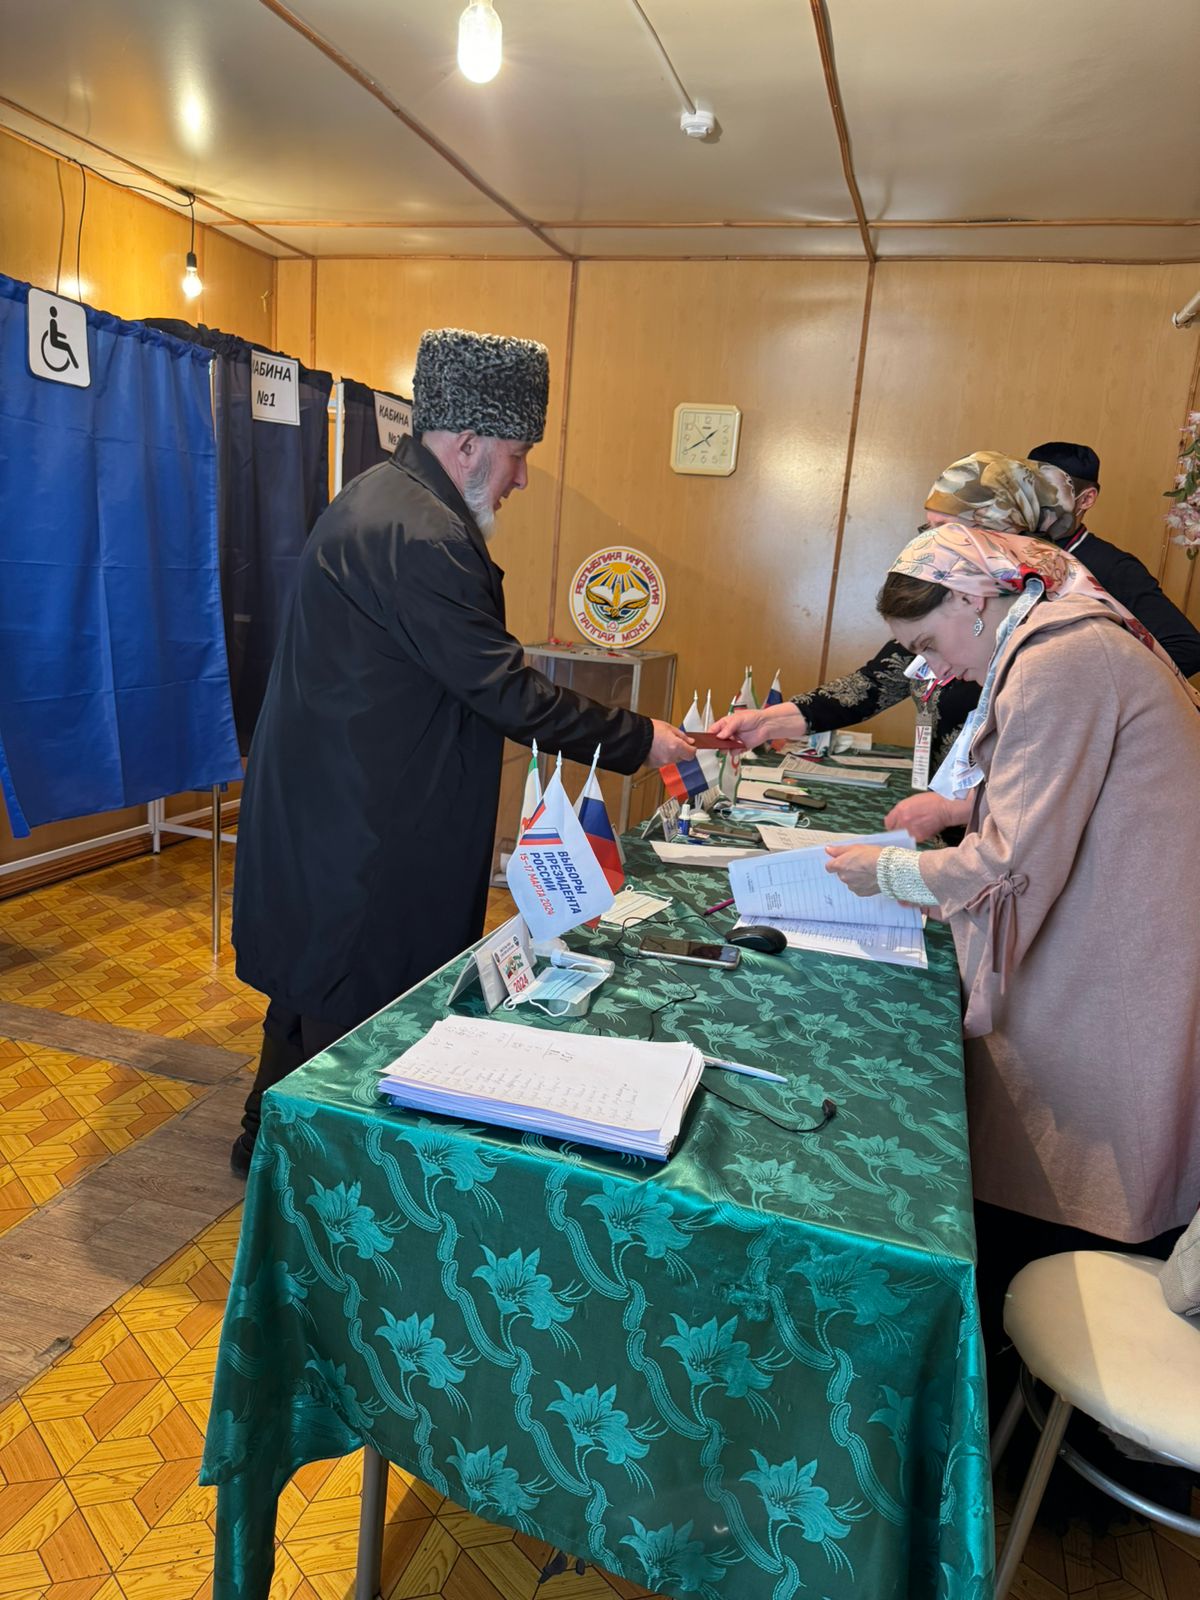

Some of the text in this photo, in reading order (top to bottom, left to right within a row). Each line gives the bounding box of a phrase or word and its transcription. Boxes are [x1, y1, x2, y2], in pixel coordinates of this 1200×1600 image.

[256, 390, 276, 407] №1
[379, 404, 409, 427] КАБИНА
[575, 552, 660, 605] РЕСПУБЛИКА ИНГУШЕТИЯ
[528, 873, 545, 897] МАРТА
[530, 852, 557, 892] РОССИИ
[543, 851, 582, 914] ПРЕЗИДЕНТА
[557, 851, 587, 895] ВЫБОРЫ
